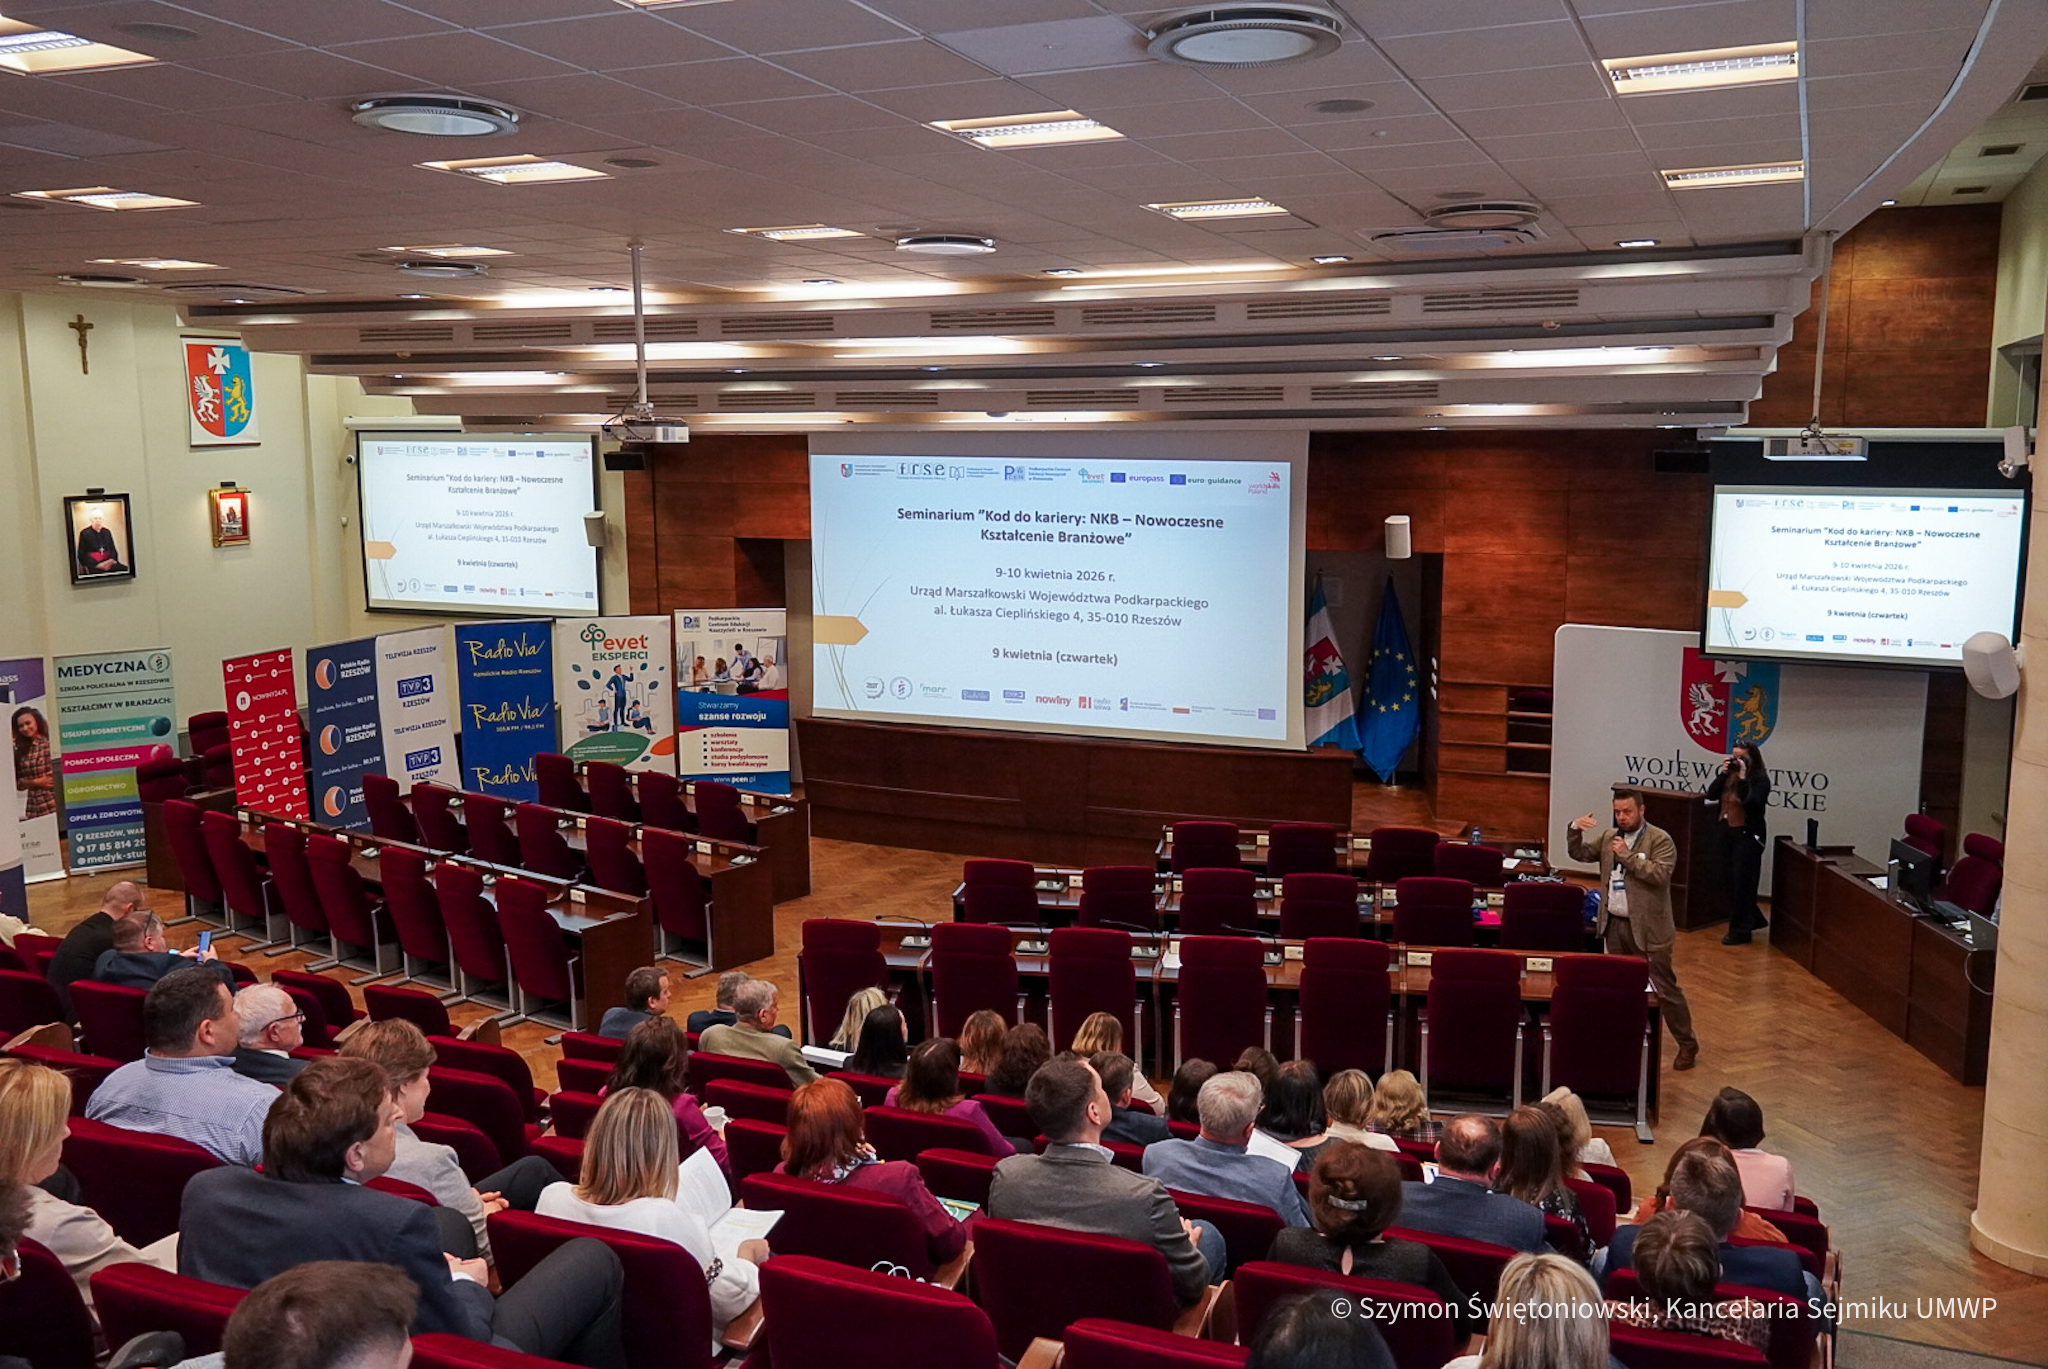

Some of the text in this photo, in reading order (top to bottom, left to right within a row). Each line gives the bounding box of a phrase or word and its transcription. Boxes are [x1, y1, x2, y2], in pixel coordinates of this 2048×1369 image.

[900, 462, 945, 476] frse
[406, 473, 446, 481] Seminarium
[464, 474, 472, 482] do
[521, 476, 564, 484] Nowoczesne
[1128, 475, 1164, 483] europass
[897, 508, 975, 522] Seminarium
[1014, 510, 1031, 523] do
[1034, 510, 1086, 526] kariery:
[1090, 513, 1119, 525] NKB
[1135, 514, 1224, 529] Nowoczesne
[980, 528, 1054, 542] Kształcenie
[1771, 526, 1822, 534] Seminarium
[1846, 527, 1858, 536] do
[1860, 528, 1893, 537] kariery:
[1924, 530, 1981, 538] Nowoczesne
[457, 558, 518, 569] 9 kwietnia (czwartek)
[995, 567, 1116, 582] 9-10 kwietnia 2026 r.
[910, 585, 1209, 610] Urząd Marszałkowski Województwa Podkarpackiego
[934, 604, 1182, 626] al. Łukasza Cieplińskiego 4, 35-010 Rzeszów
[1827, 609, 1908, 620] 9 kwietnia (czwartek)
[603, 634, 648, 650] evet
[385, 646, 437, 660] TELEWIZJA RZESZÓW
[463, 632, 546, 666] Radio Via
[592, 651, 648, 661] EKSPERCI
[992, 648, 1118, 667] 9 kwietnia (czwartek)
[58, 660, 147, 678] MEDYCZNA
[340, 665, 371, 679] RZESZÓW
[86, 681, 126, 690] POLICEALNA
[135, 678, 170, 686] RZESZOWIE
[61, 702, 113, 713] KSZTAŁCIMY
[403, 696, 431, 708] RZESZÓW
[698, 701, 740, 710] Stwarzamy
[1035, 696, 1072, 707] nowiny
[467, 695, 549, 730] Radio Via
[698, 711, 767, 722] szanse rozwoju
[62, 724, 146, 739] USŁUGI KOSMETYCZNE
[394, 724, 421, 735] TELEWIZJA
[65, 754, 140, 766] POMOC SPOŁECZNA
[470, 764, 520, 792] Radio
[1624, 755, 1829, 791] WOJEWTWO
[713, 776, 756, 784] www.pcen.pl
[67, 782, 126, 794] OGRODNICTWO
[1626, 776, 1826, 812] PODKACKIE
[69, 809, 144, 822] OPIEKA ZDROWOTN
[127, 827, 145, 835] WAR
[86, 844, 97, 853] 17
[99, 842, 112, 851] 85
[114, 841, 132, 849] 814
